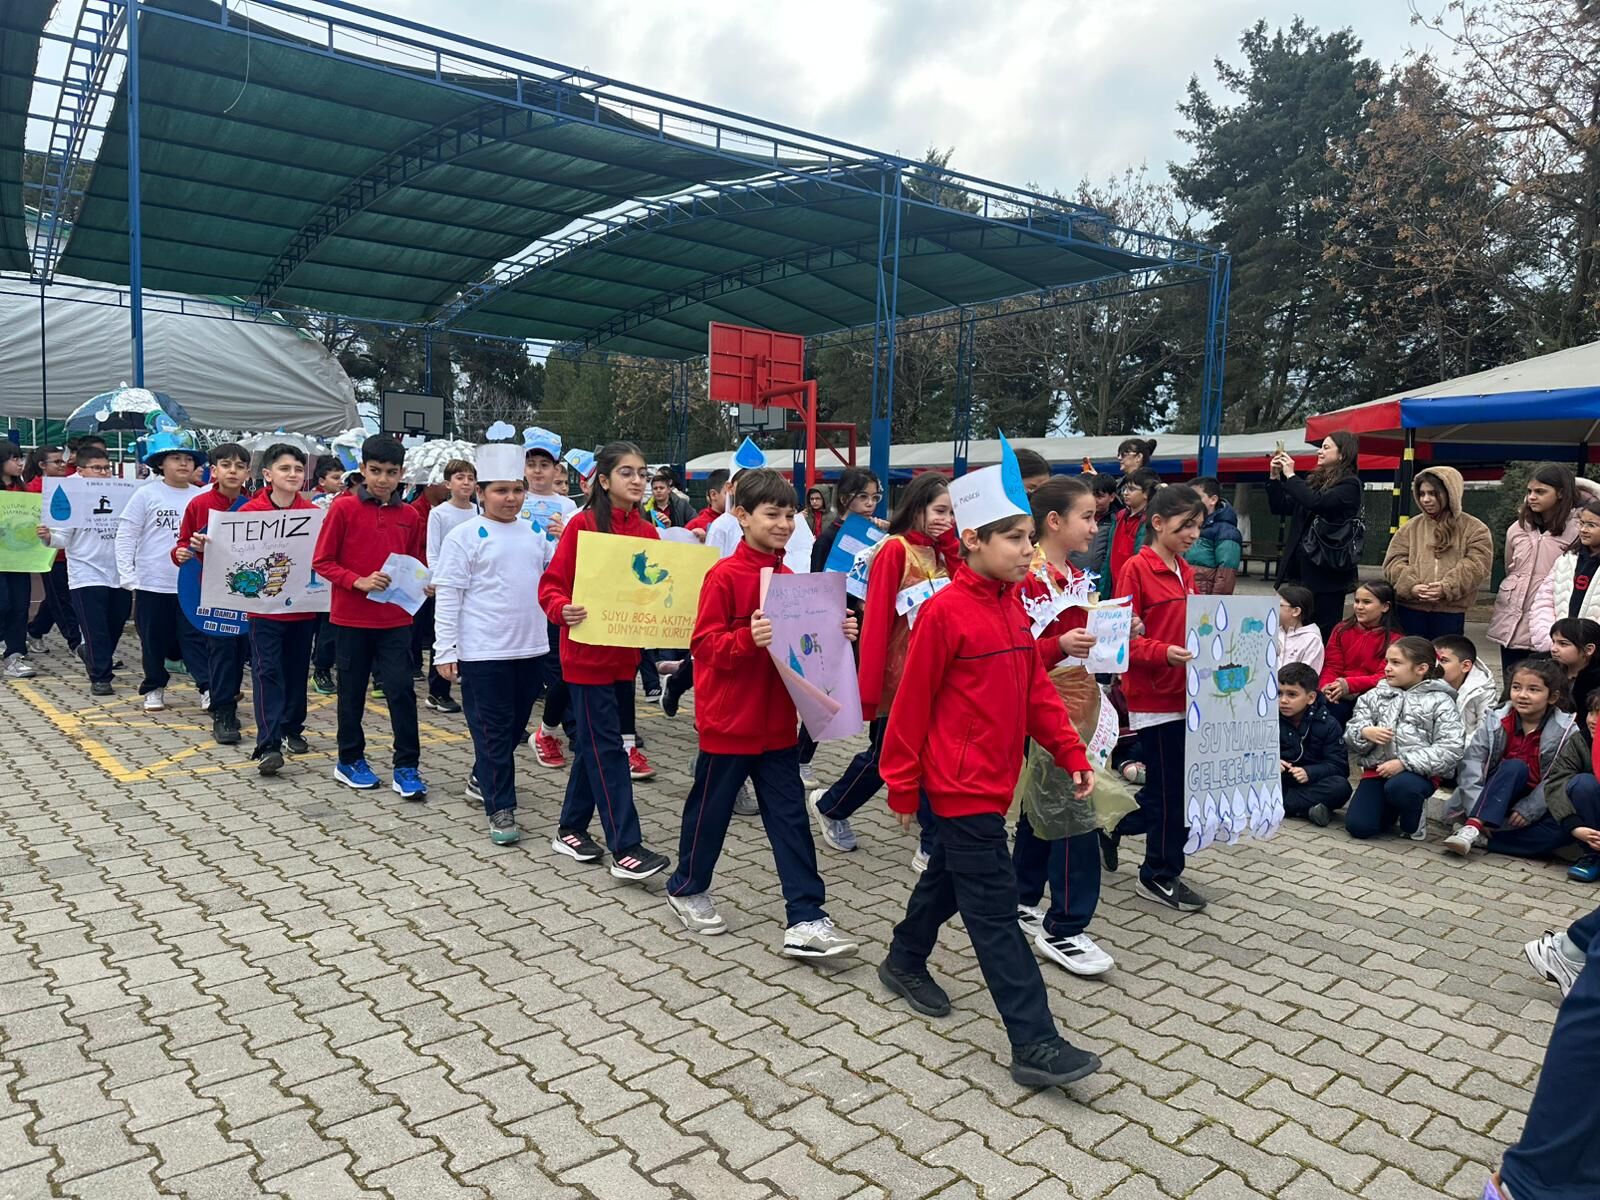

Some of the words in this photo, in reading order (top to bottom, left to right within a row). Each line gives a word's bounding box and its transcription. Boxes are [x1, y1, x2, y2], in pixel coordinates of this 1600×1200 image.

[156, 518, 181, 530] SAL
[221, 514, 311, 543] TEMİZ
[197, 607, 210, 616] BİR
[214, 609, 236, 619] DAMLA
[601, 610, 628, 622] SUYU
[204, 621, 216, 630] BİR
[220, 624, 240, 633] UMUT
[661, 628, 692, 639] KURUT
[1198, 719, 1279, 754] SUYUMUZ
[1188, 751, 1279, 792] GELECEĞİMİZ
